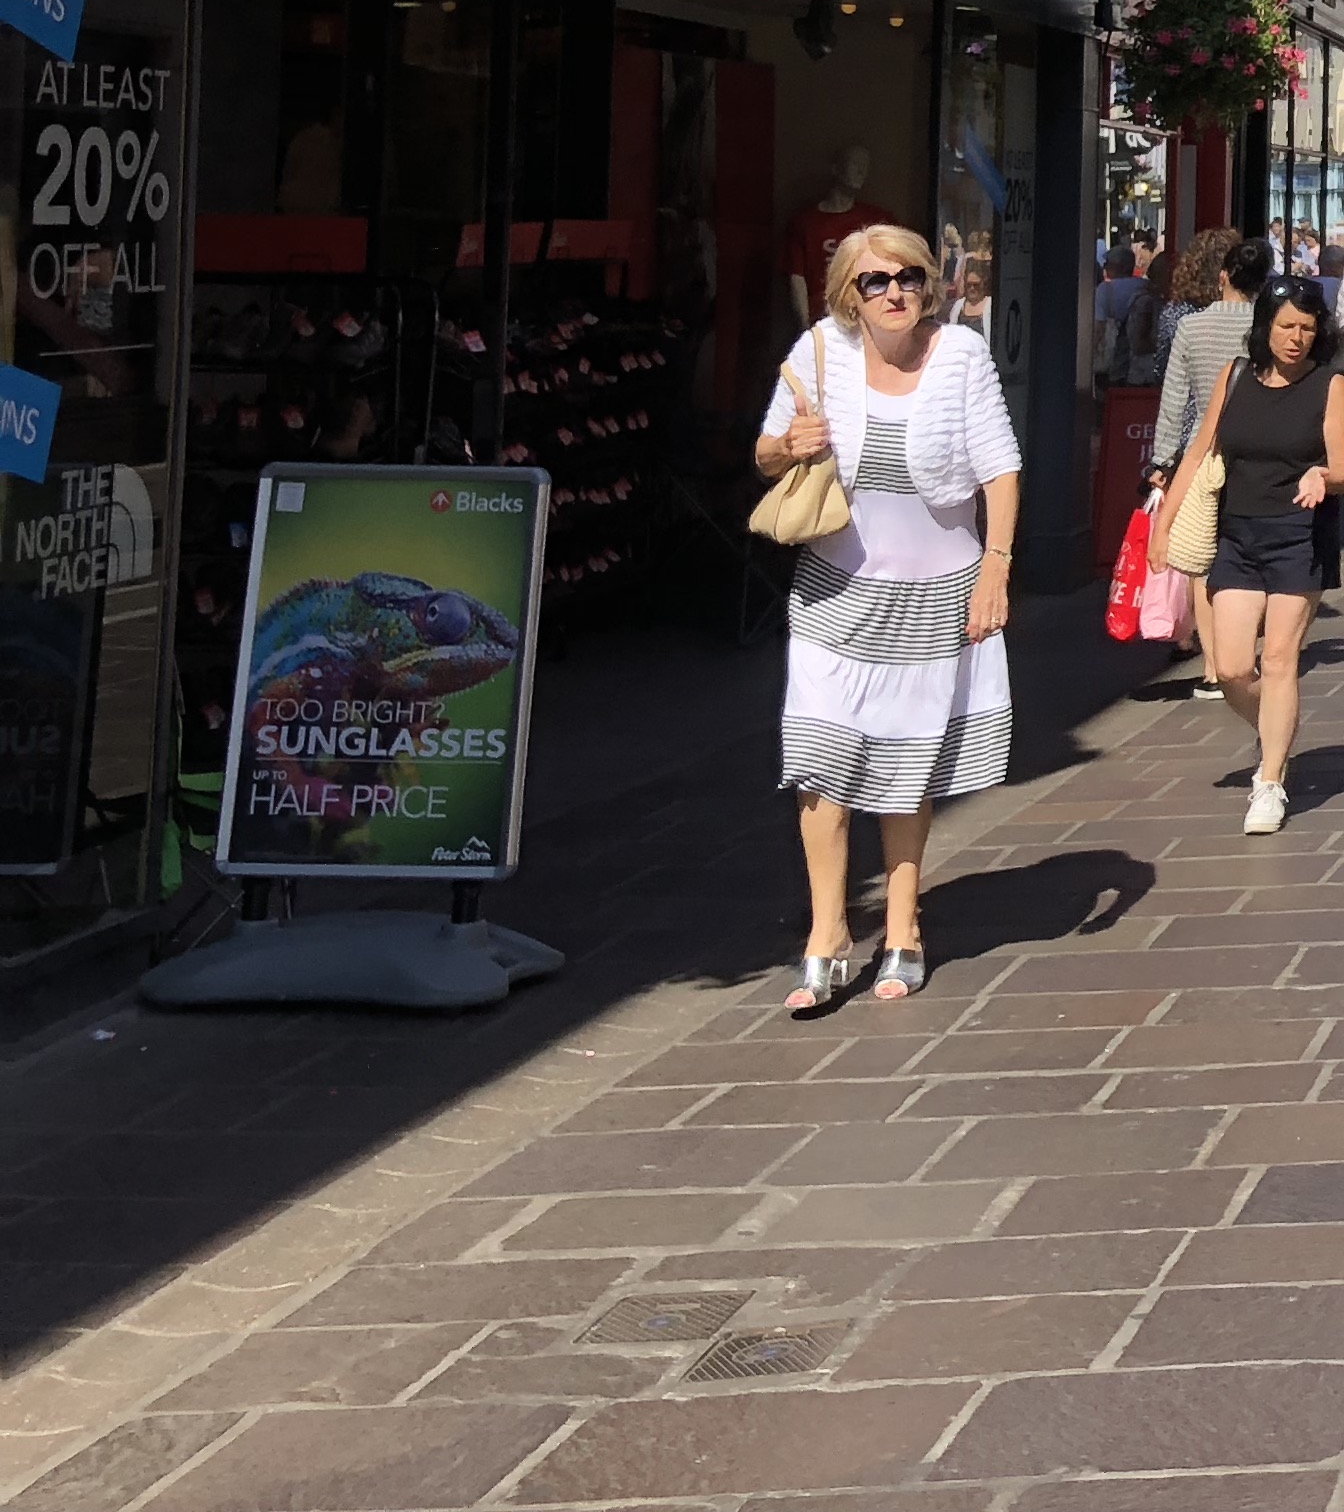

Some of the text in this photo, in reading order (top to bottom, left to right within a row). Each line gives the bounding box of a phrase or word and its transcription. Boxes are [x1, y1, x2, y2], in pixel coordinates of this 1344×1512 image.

[36, 60, 171, 112] AT LEAST
[32, 123, 170, 227] 20%
[29, 241, 166, 299] OFF ALL
[1127, 423, 1155, 439] GE
[61, 464, 112, 509] THE
[455, 491, 525, 514] Blacks
[16, 505, 110, 562] NORTH
[42, 547, 107, 601] FACE
[259, 697, 446, 725] TOO BRIGHT?
[255, 725, 507, 759] SUNGLASSES
[252, 769, 288, 781] UP TO
[249, 783, 449, 819] HALF PRICE
